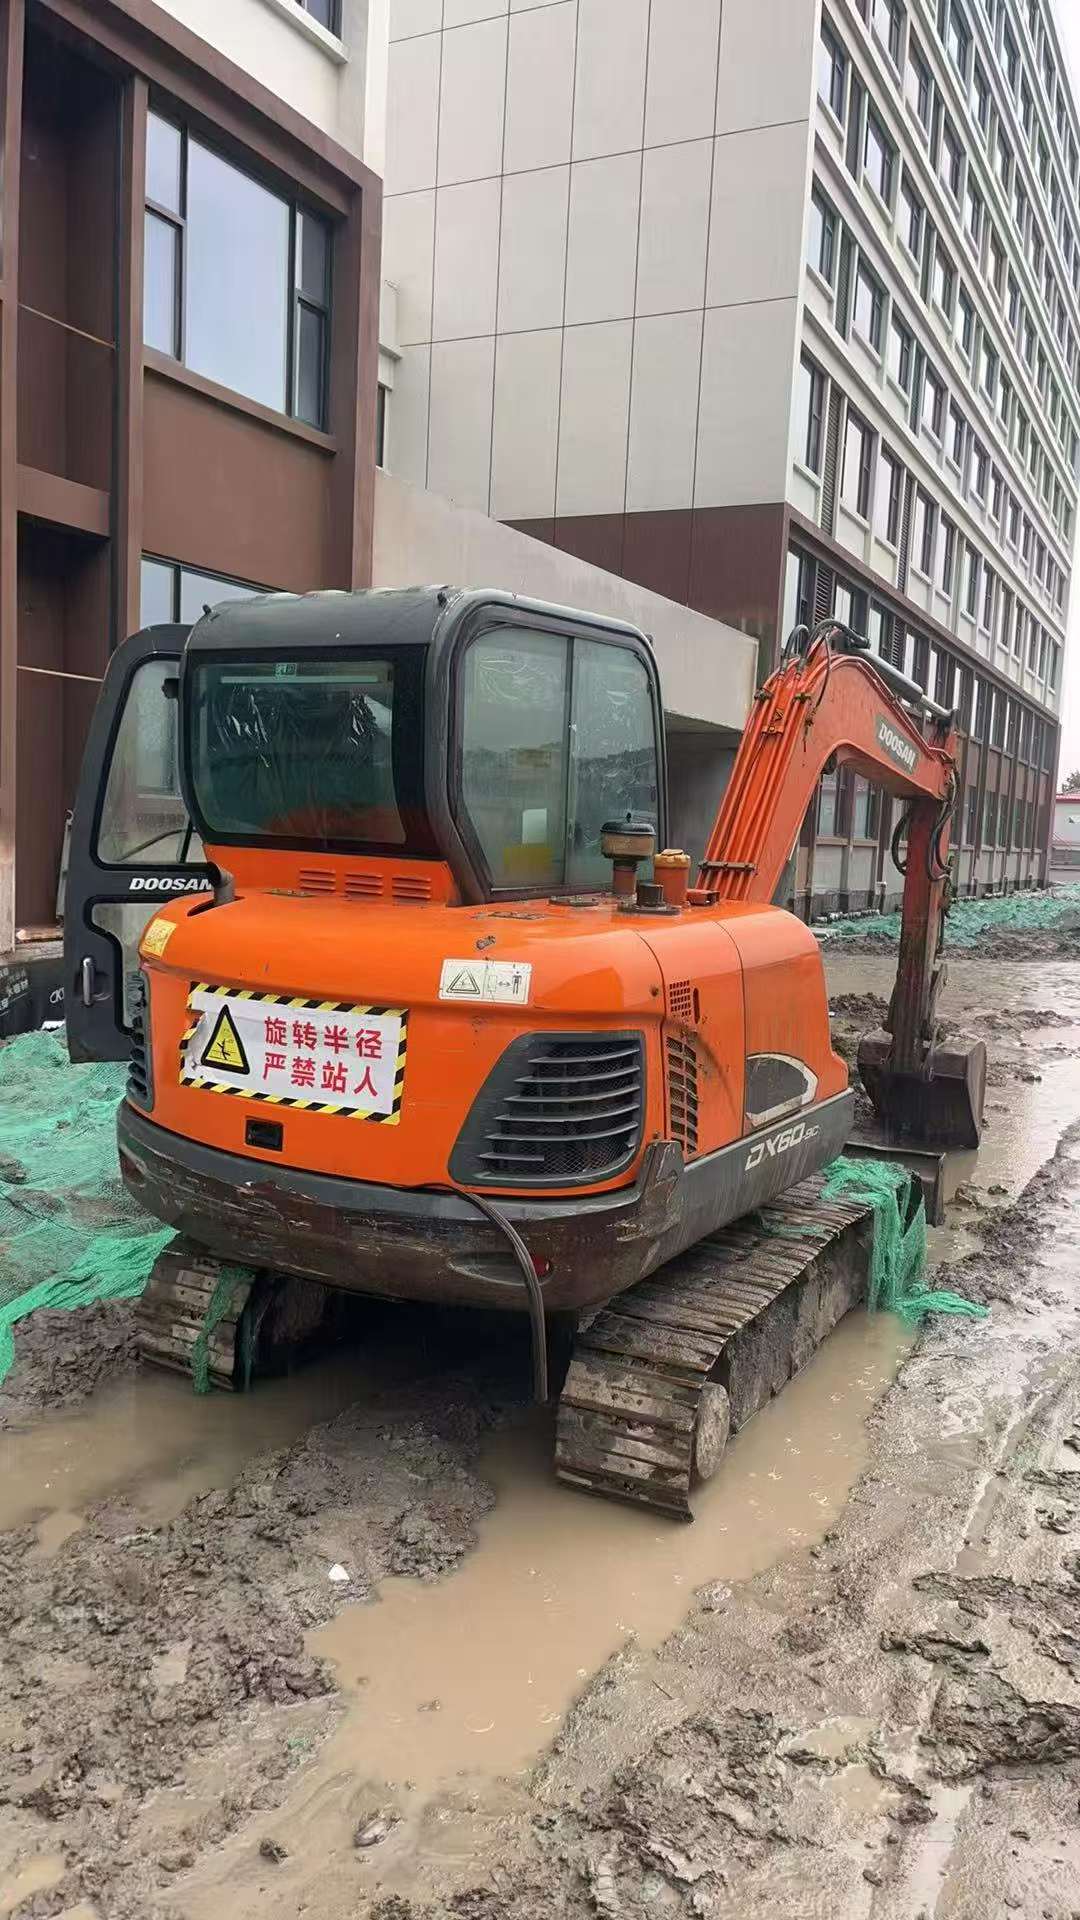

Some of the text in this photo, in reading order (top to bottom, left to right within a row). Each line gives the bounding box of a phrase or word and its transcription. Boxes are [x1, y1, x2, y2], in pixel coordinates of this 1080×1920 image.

[878, 722, 916, 768] DOOSAN
[263, 1016, 383, 1060] 旋转半径
[262, 1051, 378, 1097] 严禁站人
